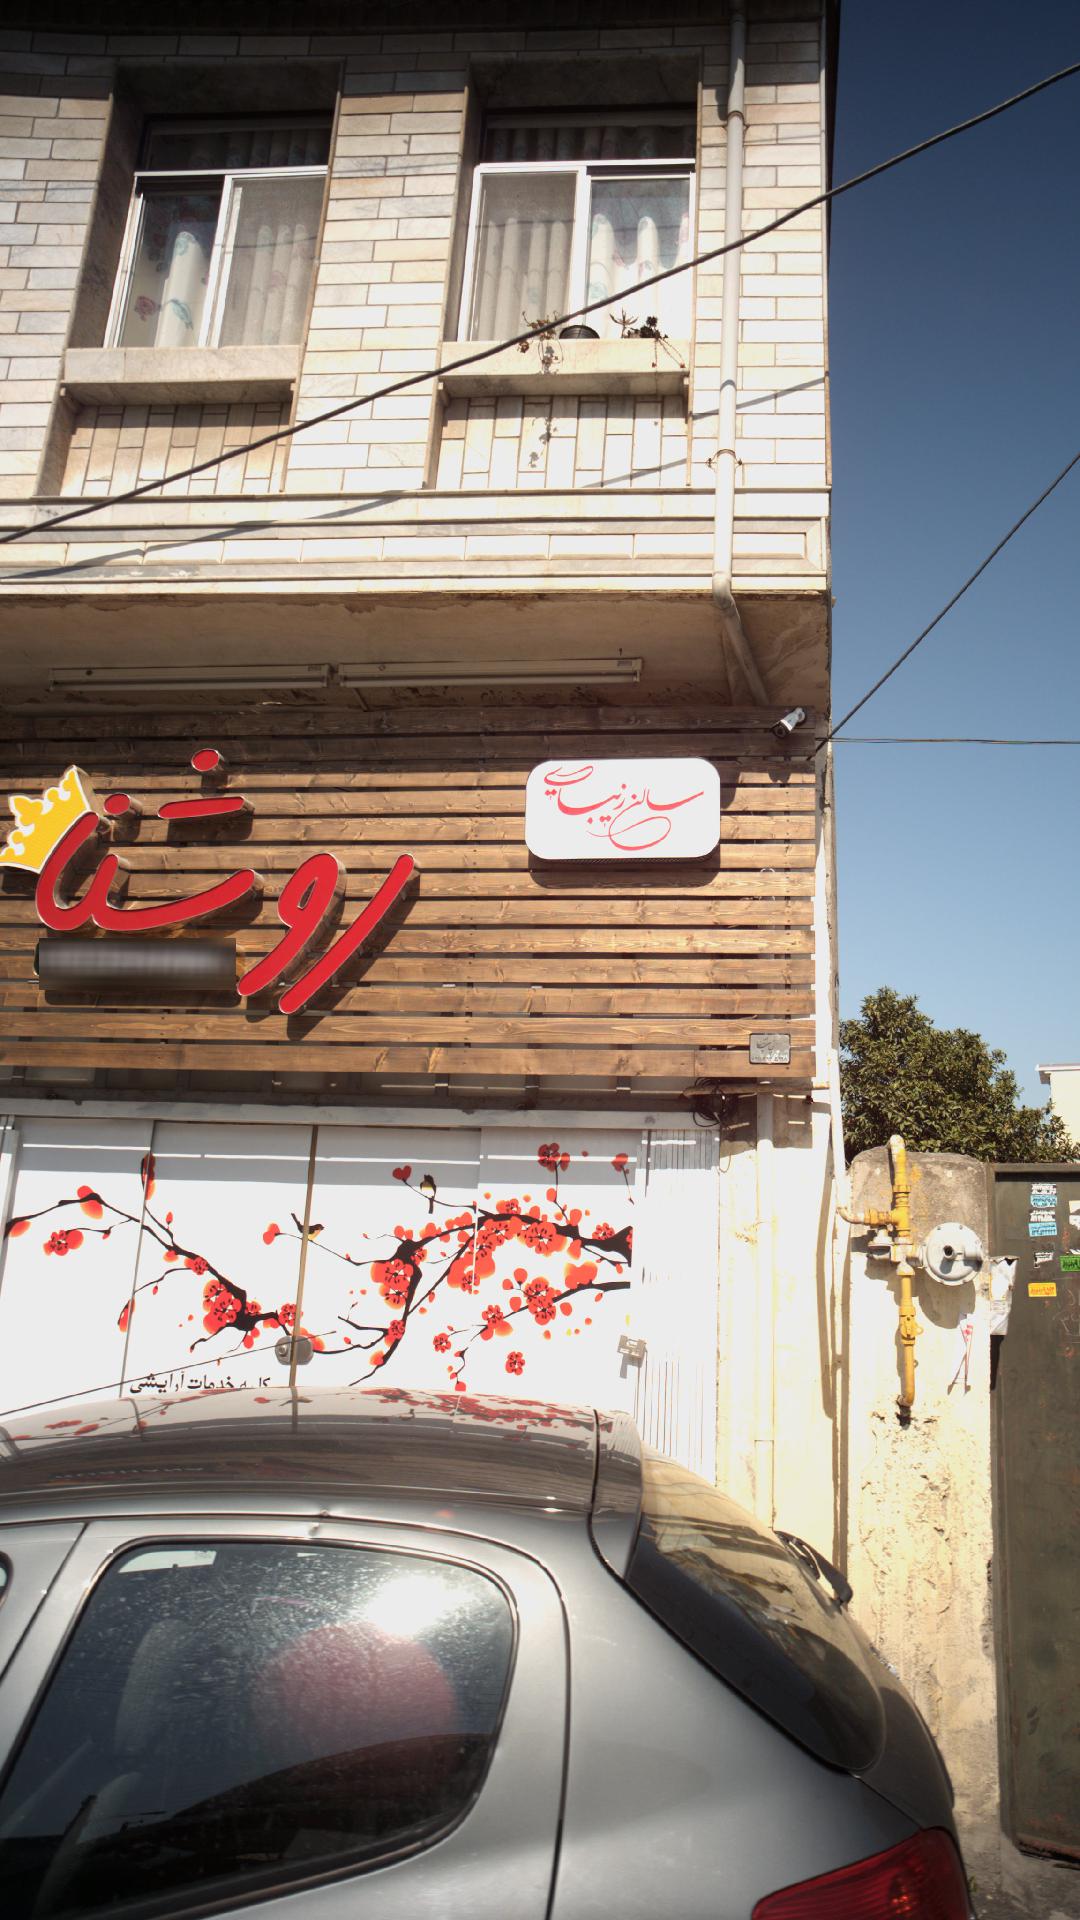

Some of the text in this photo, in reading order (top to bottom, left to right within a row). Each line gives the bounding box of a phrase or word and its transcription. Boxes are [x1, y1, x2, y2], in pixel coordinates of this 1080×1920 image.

[587, 787, 704, 851] سالن
[36, 749, 414, 1014] روشنا
[187, 1374, 235, 1389] خدمات
